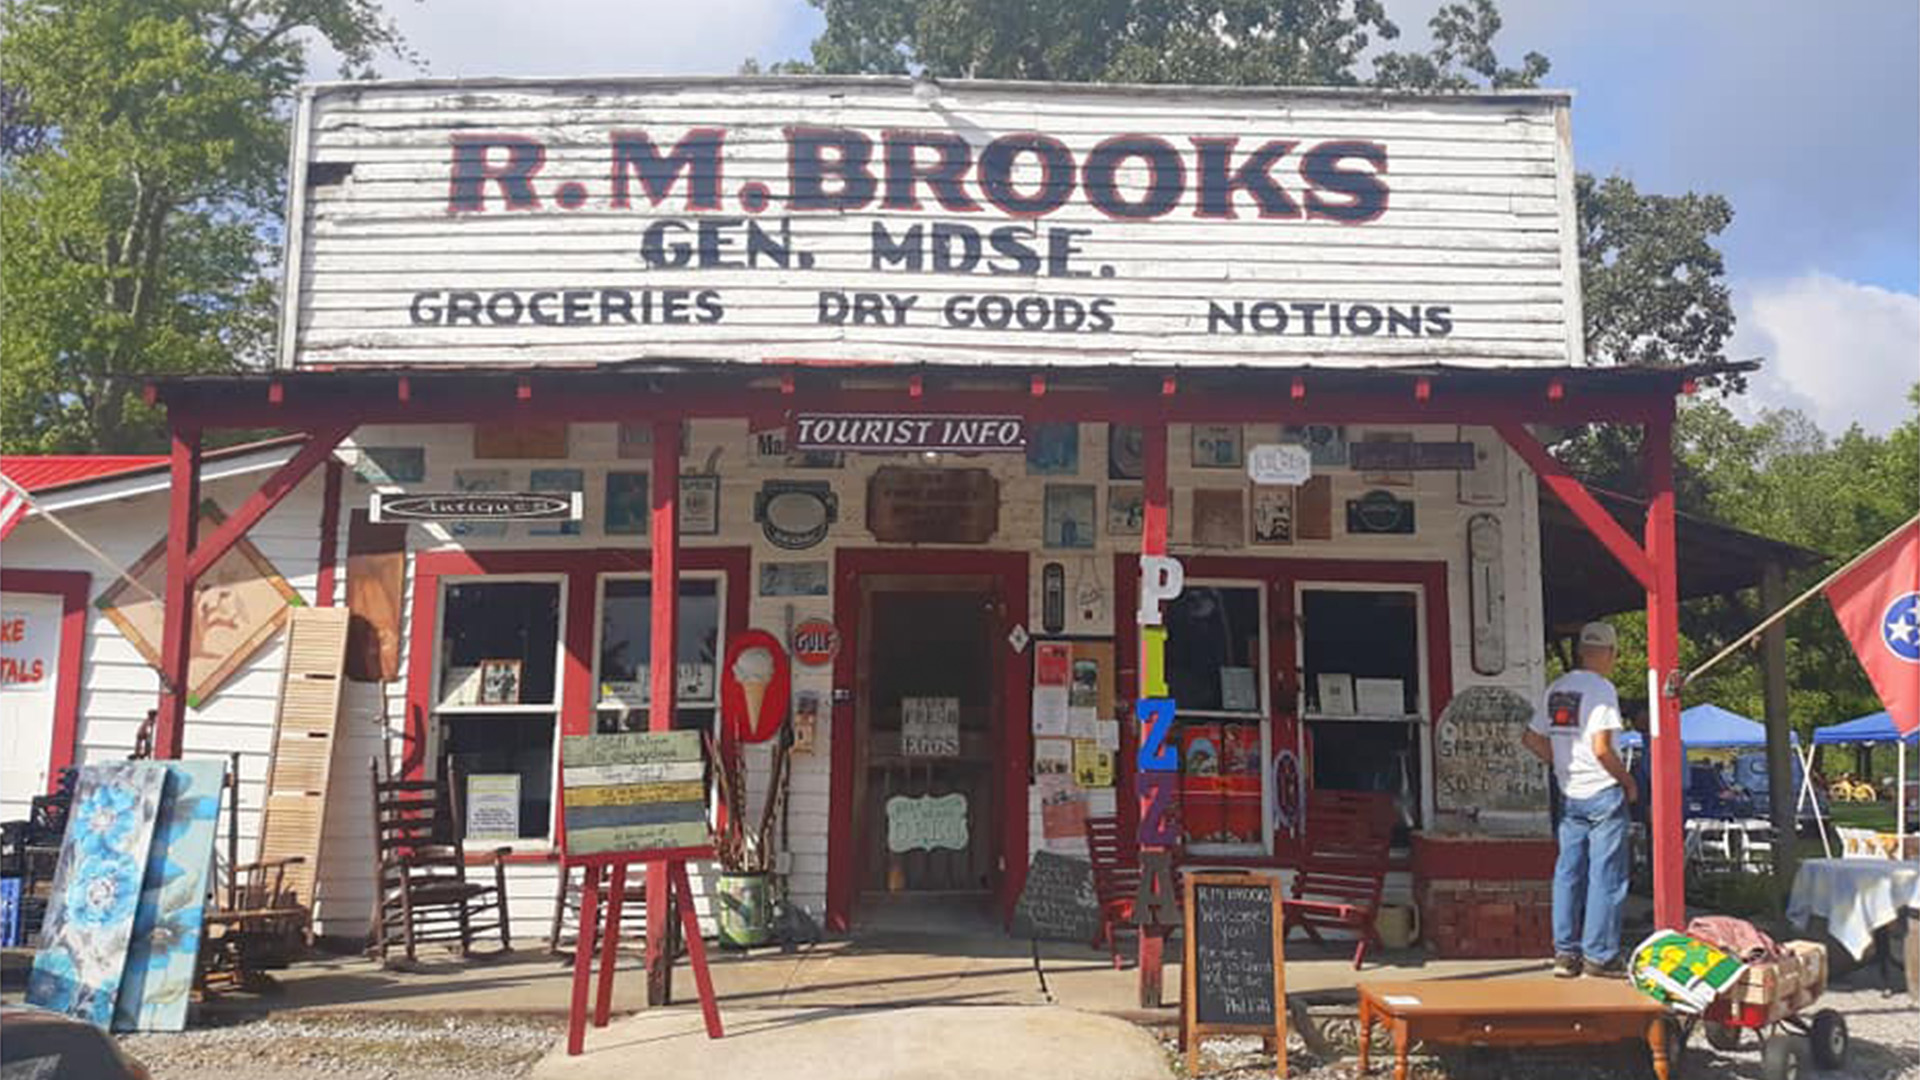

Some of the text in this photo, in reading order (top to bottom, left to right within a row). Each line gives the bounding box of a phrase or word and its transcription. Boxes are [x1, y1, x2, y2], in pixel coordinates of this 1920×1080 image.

[640, 219, 1116, 279] GEN. MDSE.
[409, 290, 1453, 338] GROCERIES DRY GOODS NOTIONS
[798, 418, 1027, 445] TOURIST INFO.
[796, 631, 838, 652] GULF
[1136, 556, 1184, 925] PIZZA
